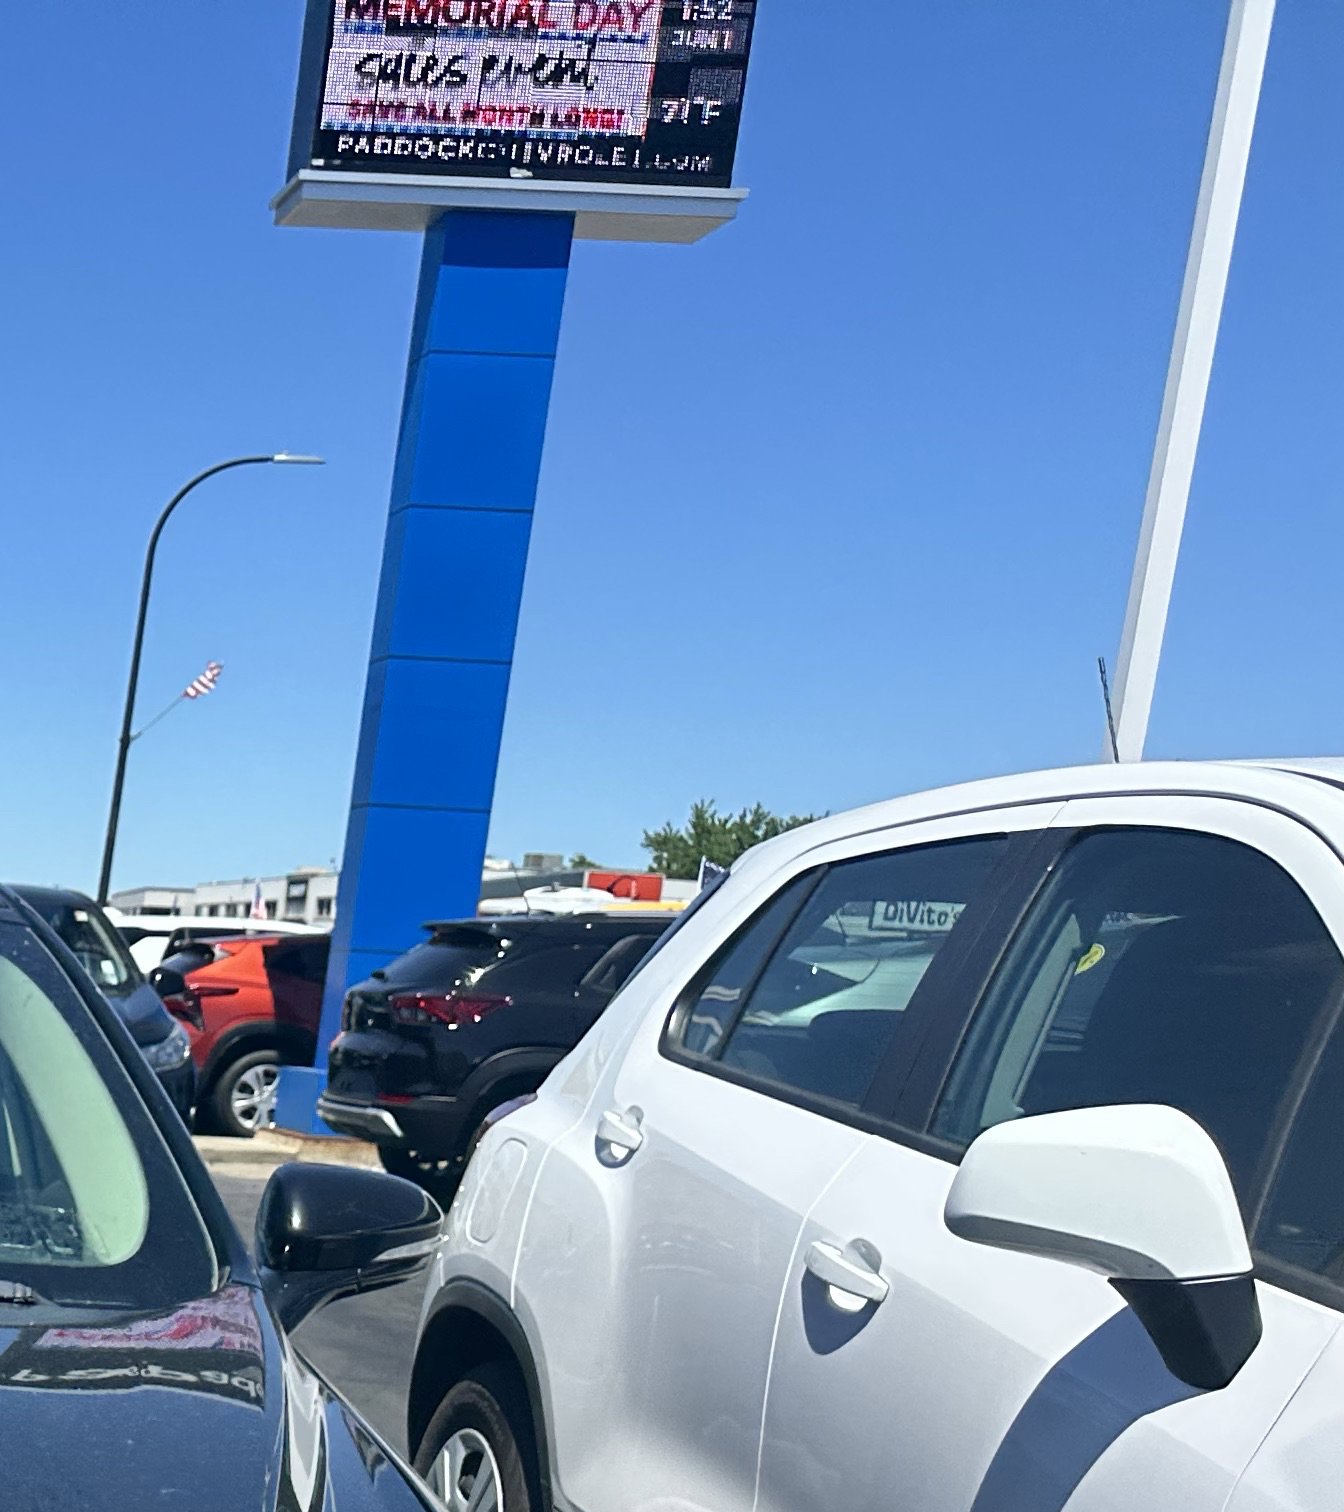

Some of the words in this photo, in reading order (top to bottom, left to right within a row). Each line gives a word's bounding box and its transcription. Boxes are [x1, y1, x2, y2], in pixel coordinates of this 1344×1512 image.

[345, 0, 556, 28] MEMORIAL
[574, 0, 653, 32] DAY
[355, 52, 468, 87] sales
[413, 102, 457, 122] ALL
